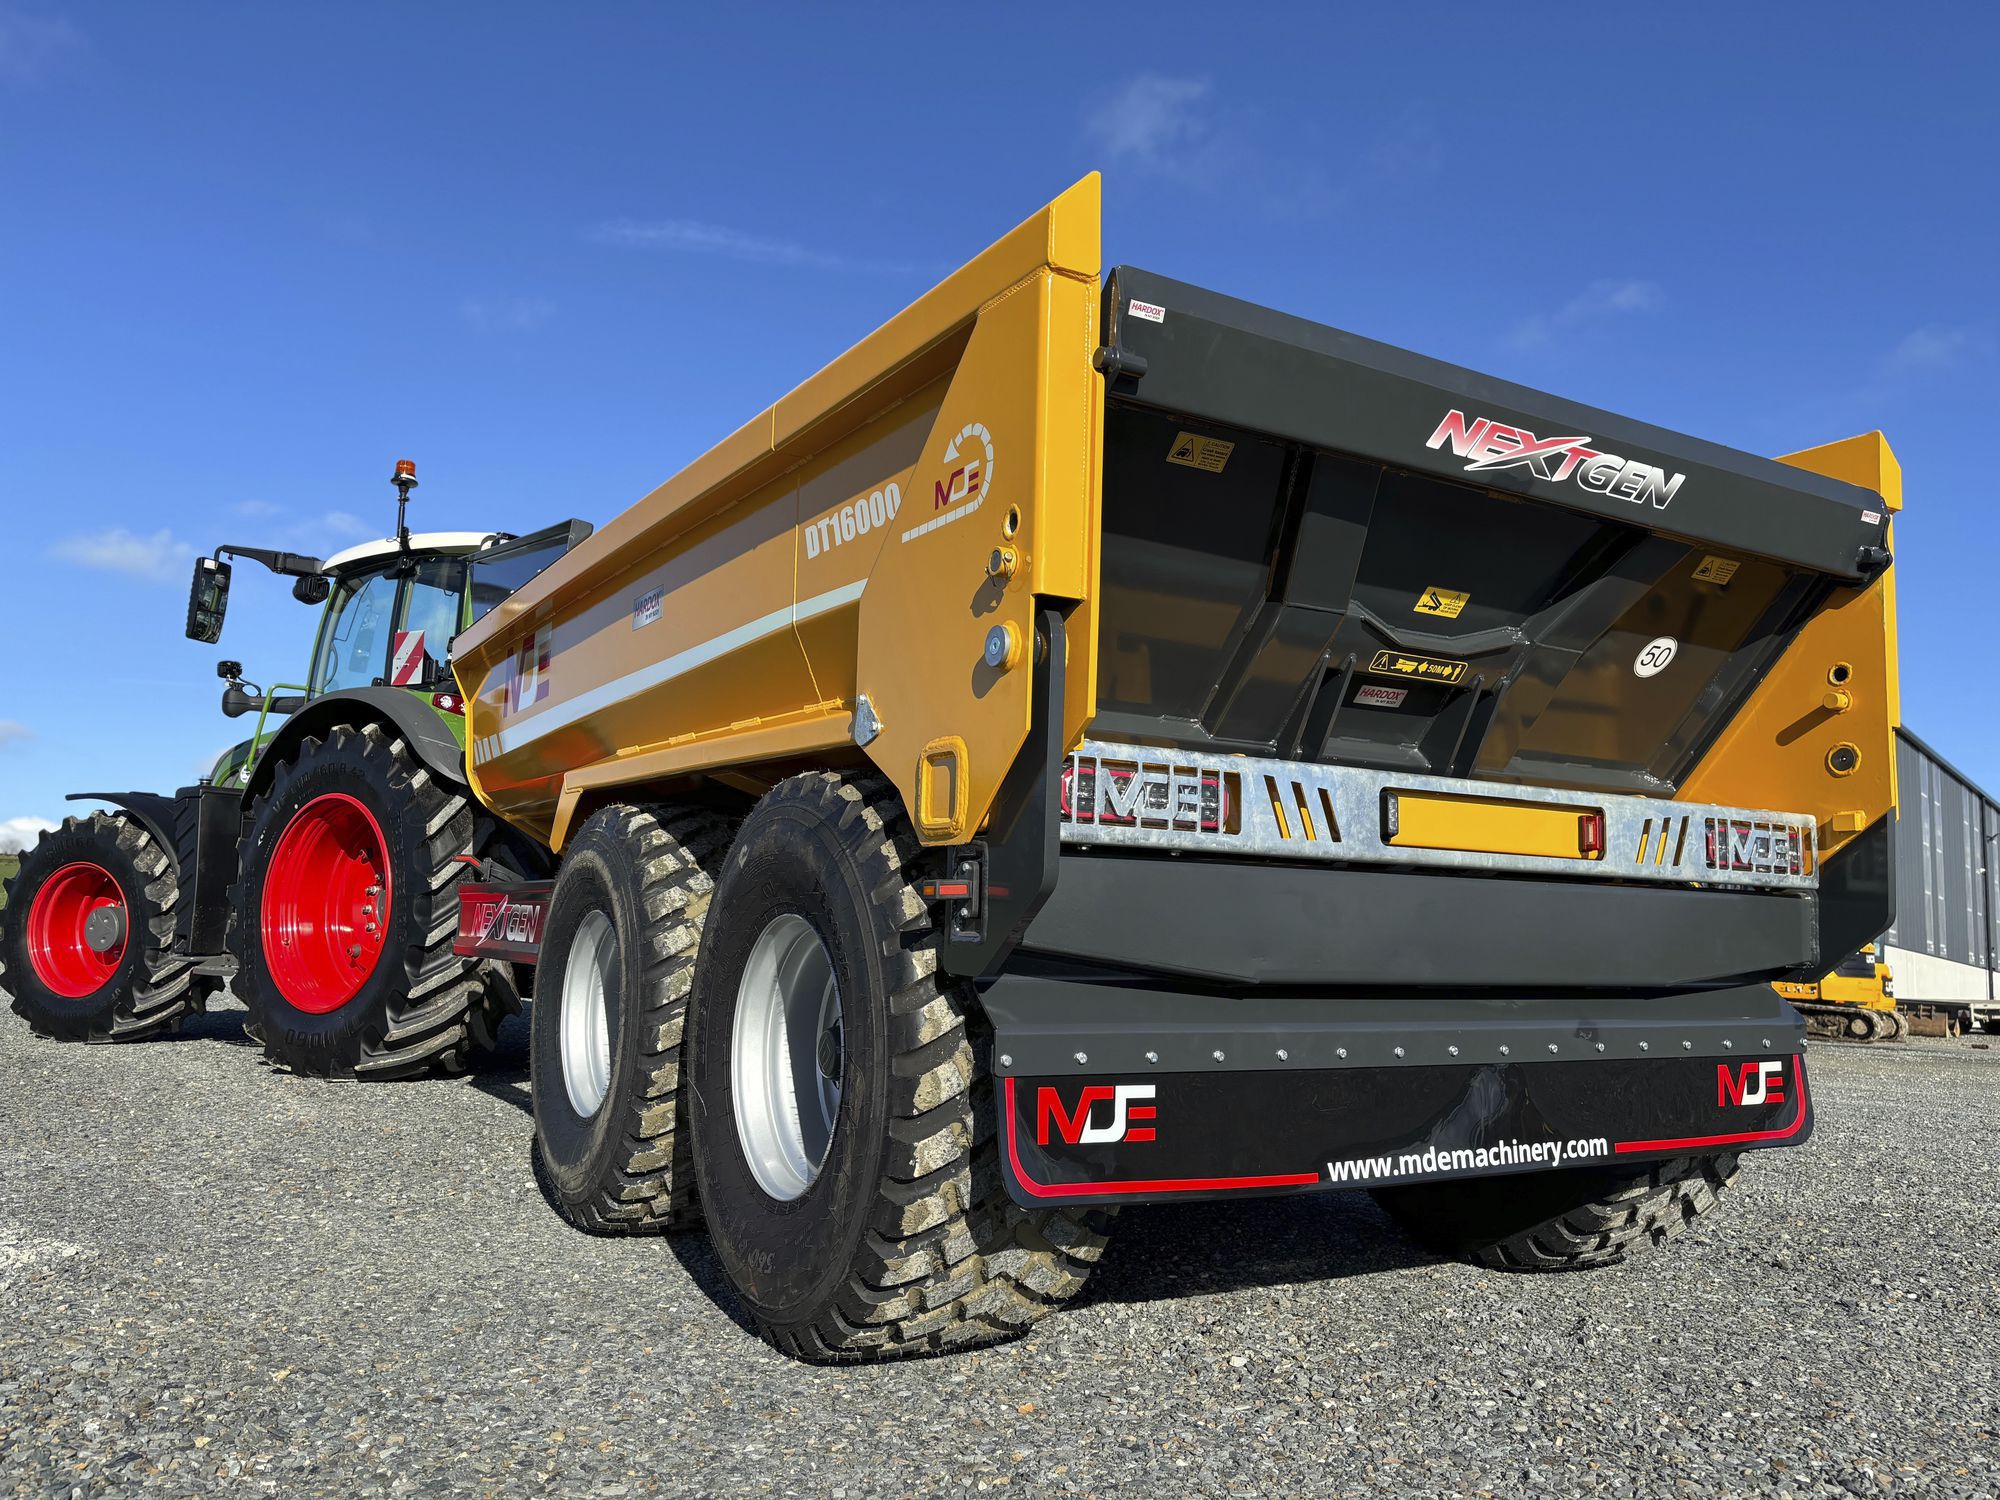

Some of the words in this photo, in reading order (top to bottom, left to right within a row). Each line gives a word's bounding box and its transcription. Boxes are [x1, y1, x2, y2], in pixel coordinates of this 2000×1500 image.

[1131, 302, 1161, 316] HARDOX
[1425, 408, 1686, 510] NEXTGEN
[804, 482, 901, 560] DT16000
[1427, 664, 1444, 675] 50M
[1640, 645, 1672, 668] 50
[1360, 688, 1402, 701] HARDOX
[470, 894, 541, 947] NEXTGEN
[1717, 1060, 1785, 1107] MDE
[1036, 1084, 1157, 1146] MDE
[1326, 1136, 1608, 1182] www.mdemachinery.com
